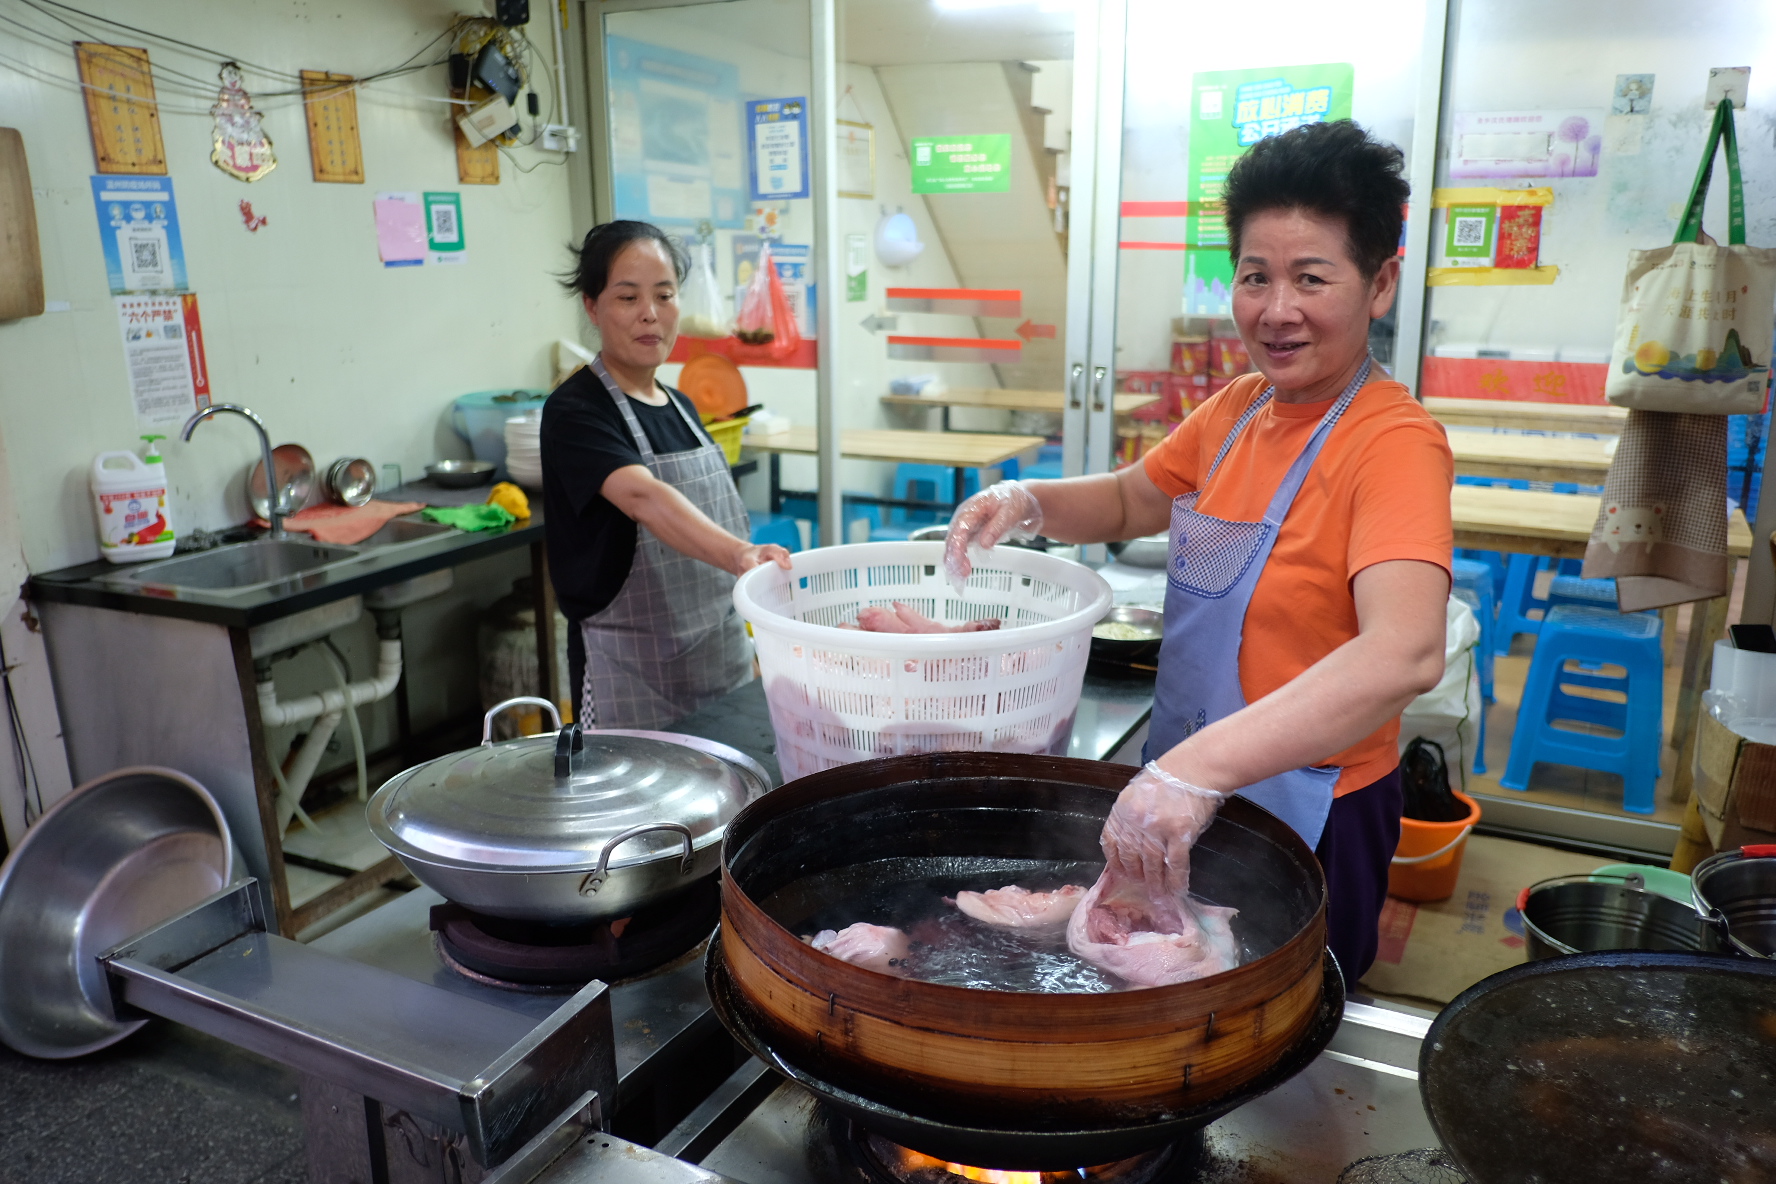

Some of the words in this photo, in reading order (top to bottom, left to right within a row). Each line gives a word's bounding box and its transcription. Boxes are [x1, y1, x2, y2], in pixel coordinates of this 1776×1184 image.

[1237, 88, 1330, 124] 放心消费
[1667, 288, 1737, 304] 海上生月
[1477, 367, 1607, 397] 欢迎
